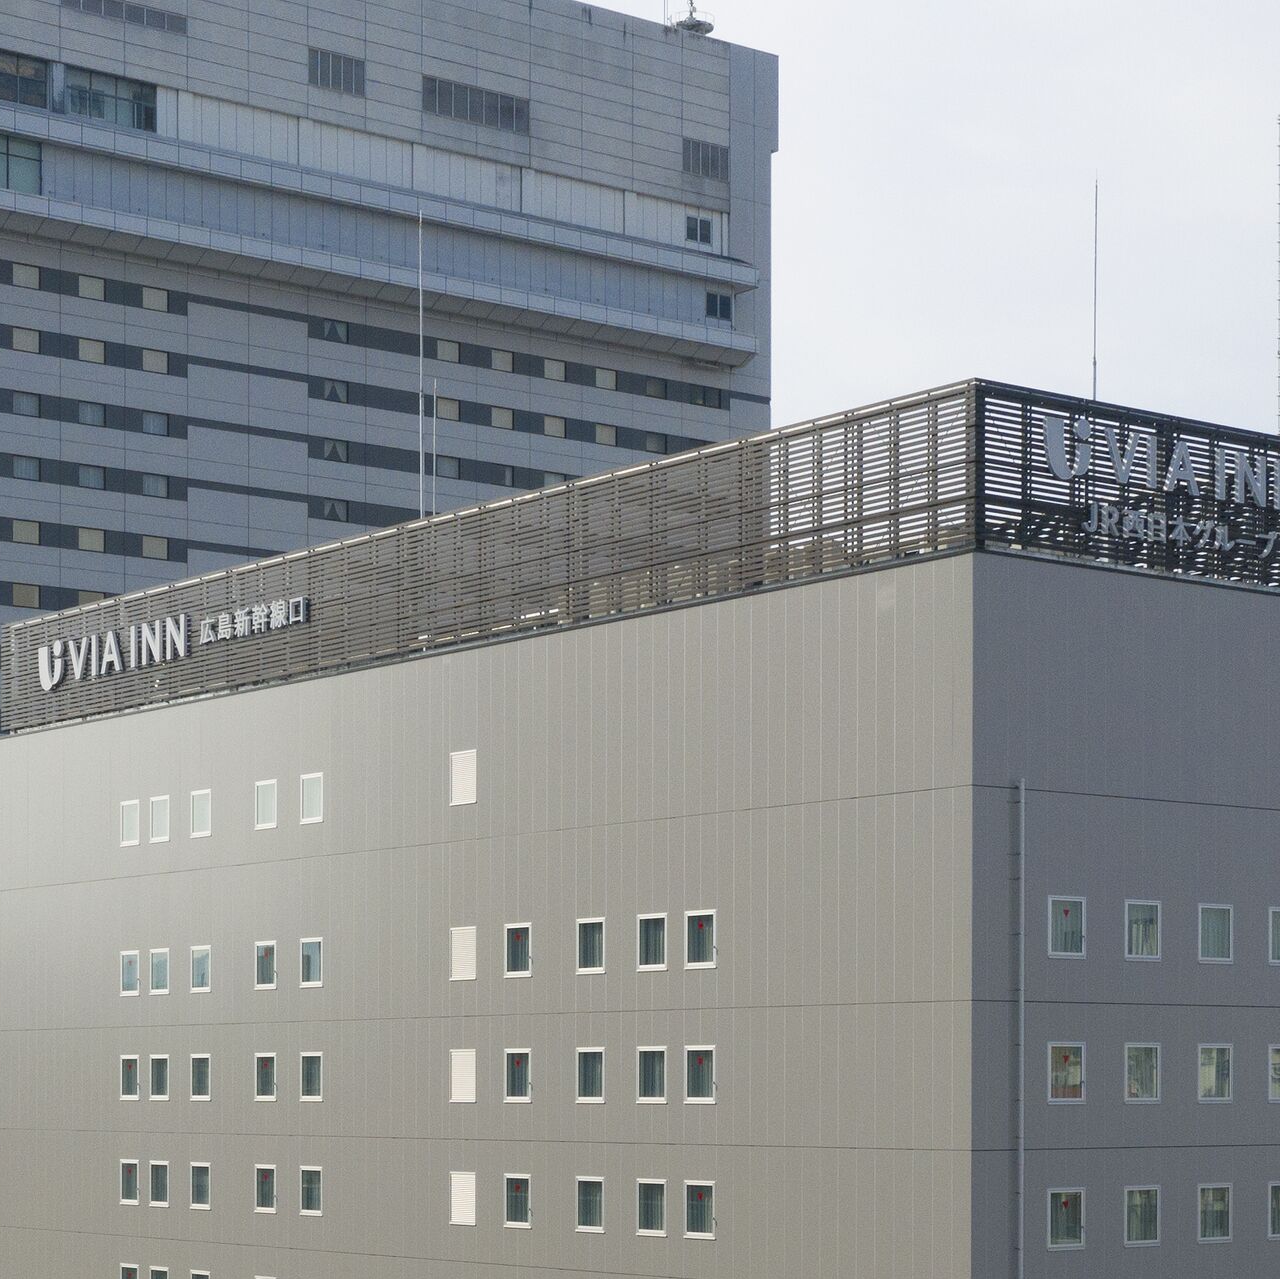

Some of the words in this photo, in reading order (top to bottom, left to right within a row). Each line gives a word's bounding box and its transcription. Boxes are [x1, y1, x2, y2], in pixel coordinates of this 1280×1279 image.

[1104, 426, 1200, 497] VIA
[1081, 502, 1279, 559] JR西日本グループ
[69, 631, 122, 680] VIA
[130, 613, 189, 668] INN
[199, 596, 309, 645] 広島新幹線口
